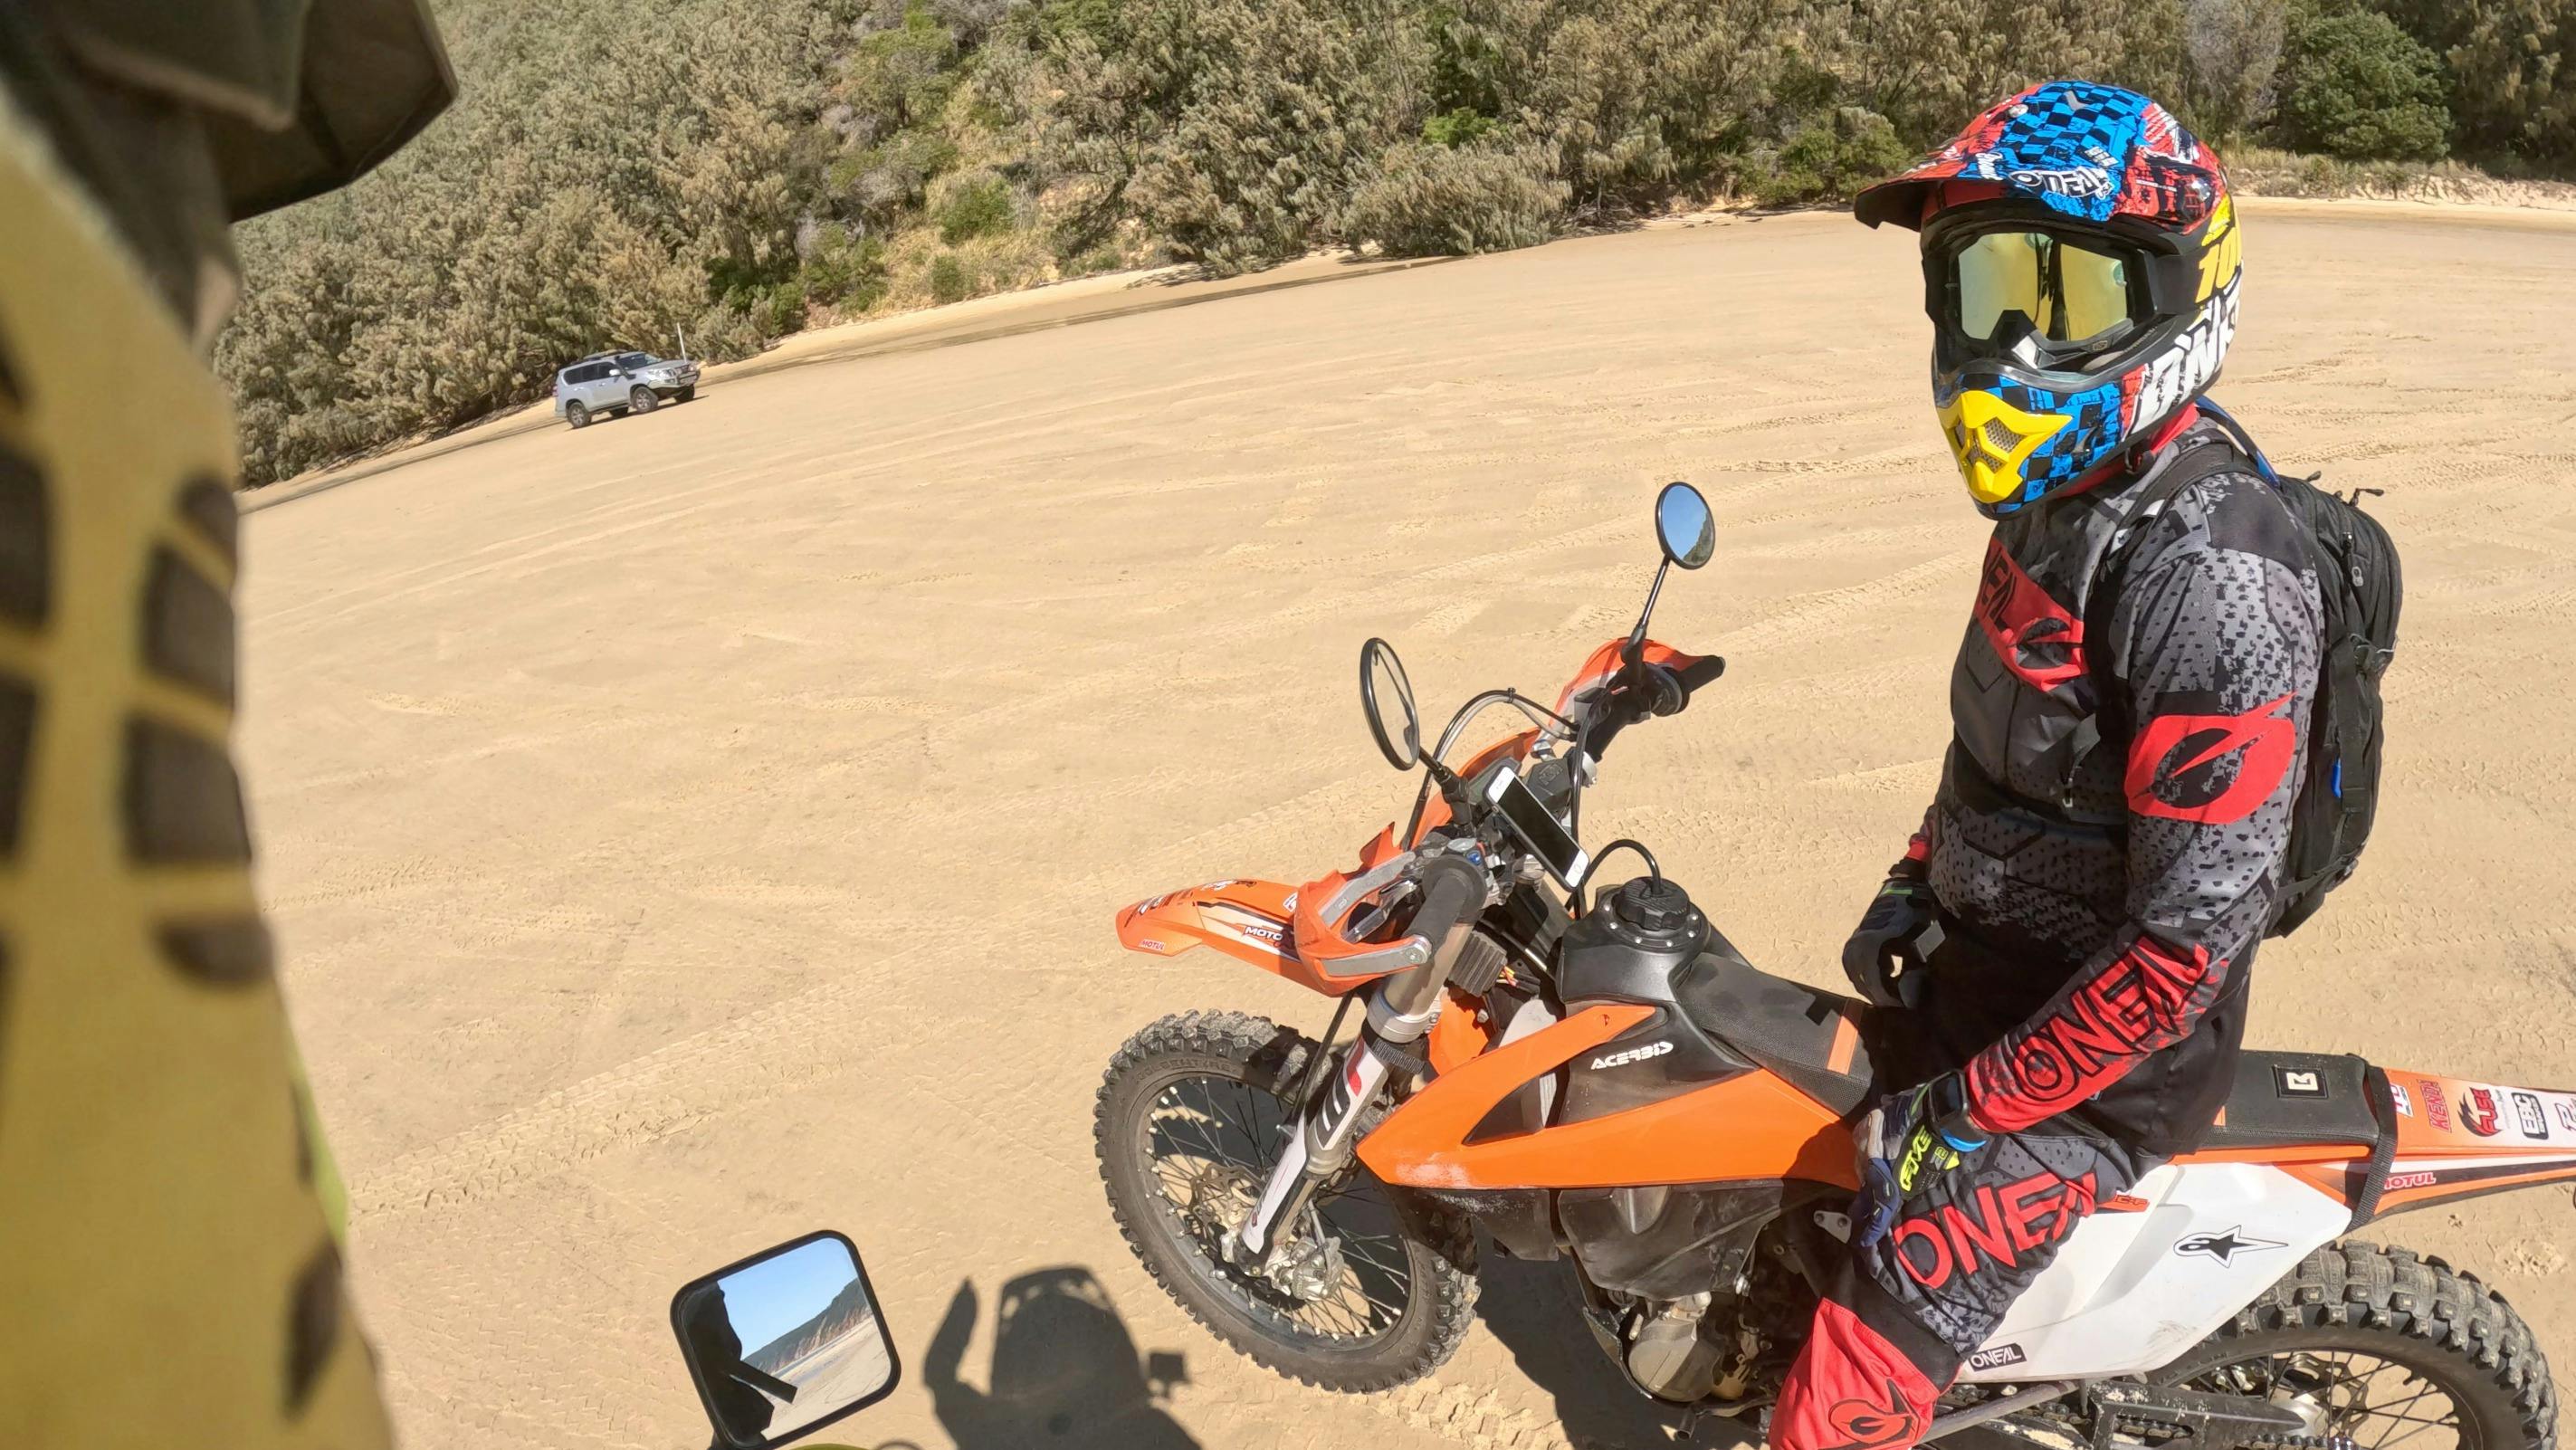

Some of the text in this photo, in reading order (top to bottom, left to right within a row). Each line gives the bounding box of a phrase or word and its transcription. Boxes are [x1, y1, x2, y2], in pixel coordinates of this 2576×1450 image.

[1245, 926, 1283, 941] MOTO
[1590, 1041, 1674, 1070] ACERBIS
[2514, 1094, 2540, 1134] EBC
[1900, 1124, 1932, 1192] FIVE
